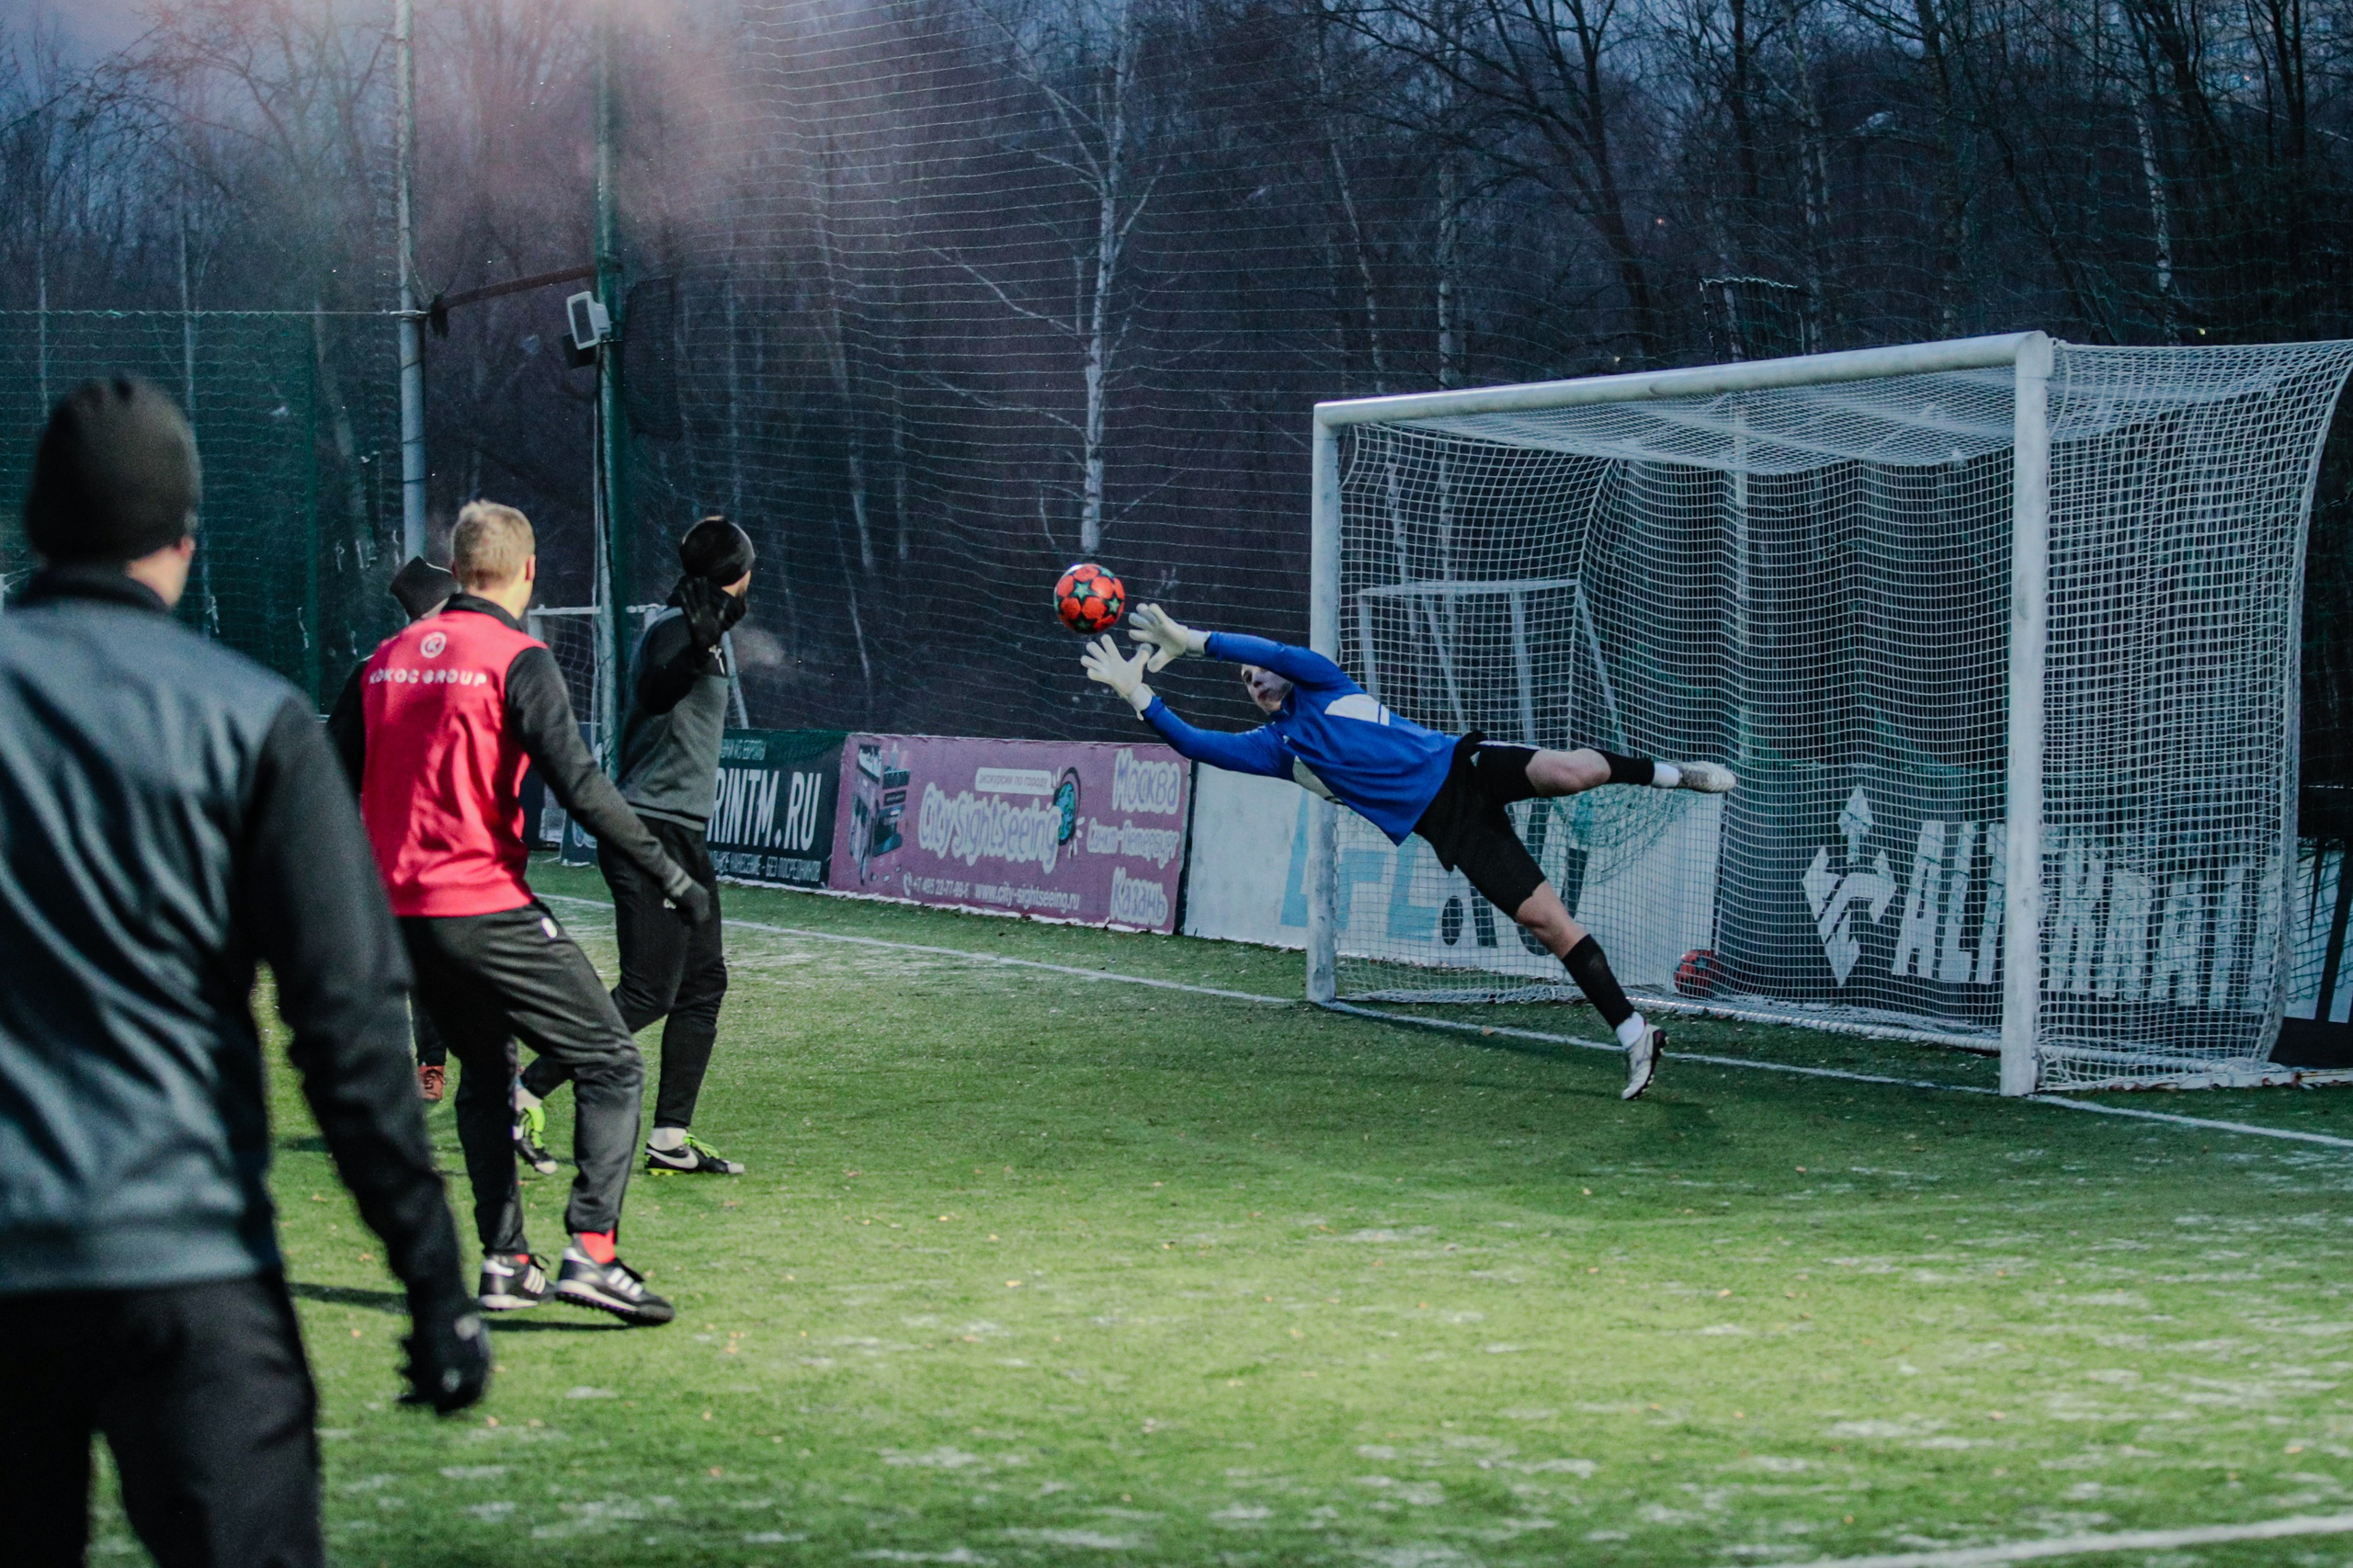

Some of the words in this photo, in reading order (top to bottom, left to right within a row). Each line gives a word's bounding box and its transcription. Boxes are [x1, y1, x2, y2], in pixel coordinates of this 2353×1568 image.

[422, 669, 488, 687] GROUP
[707, 767, 822, 851] RINTM.RU
[1112, 749, 1180, 814] Москва
[974, 881, 1080, 913] www.city-sightseeing.ru
[1110, 868, 1168, 926] Казань
